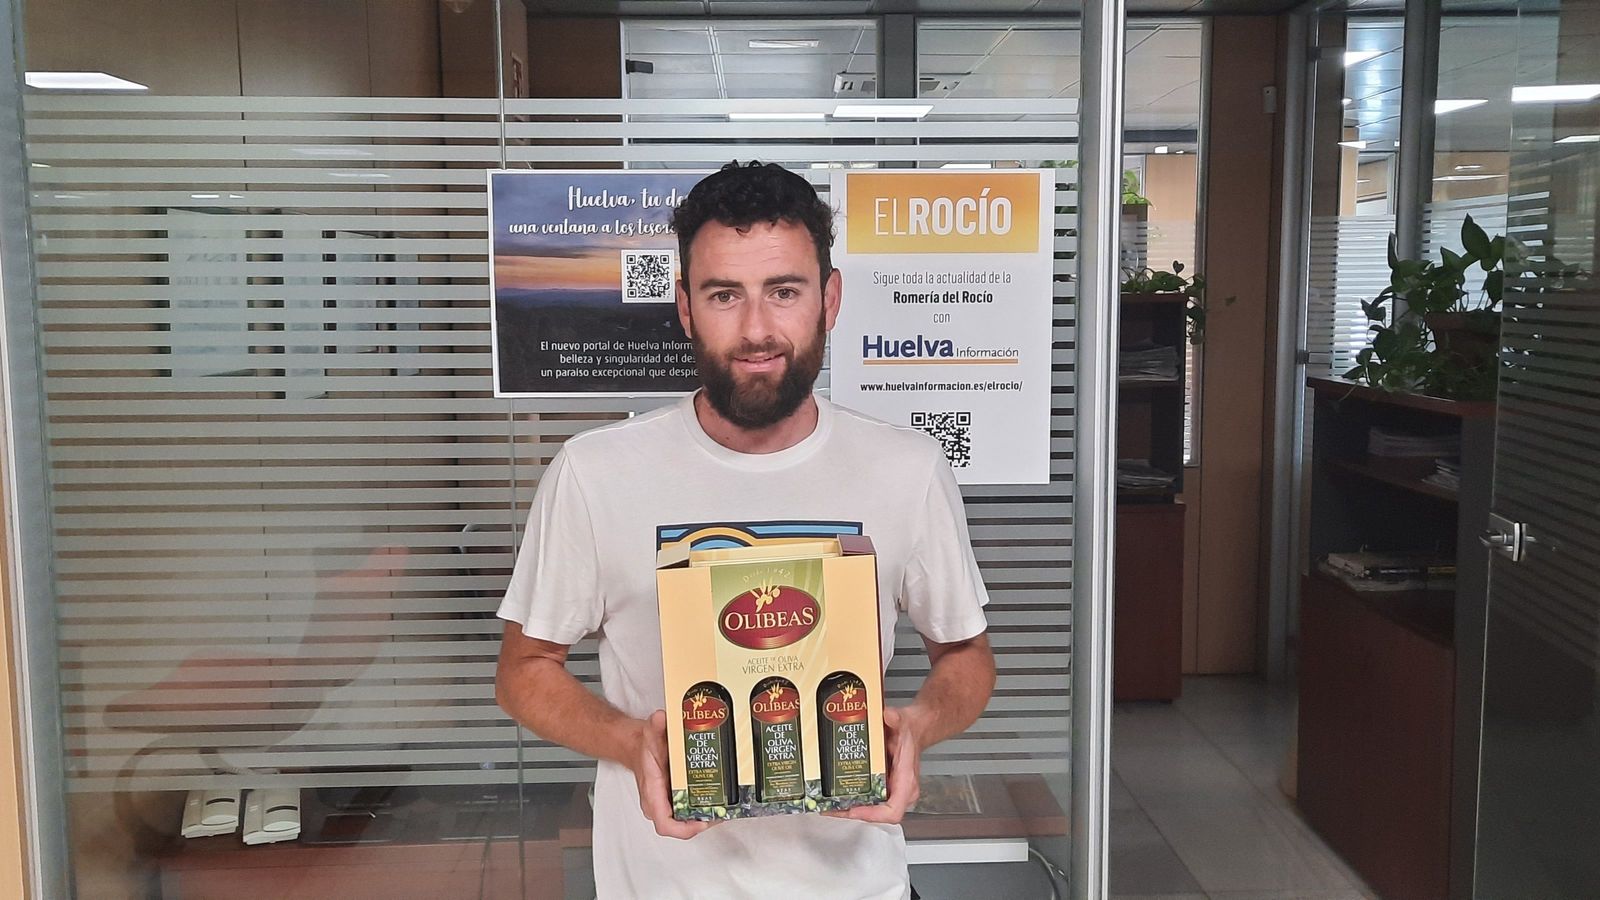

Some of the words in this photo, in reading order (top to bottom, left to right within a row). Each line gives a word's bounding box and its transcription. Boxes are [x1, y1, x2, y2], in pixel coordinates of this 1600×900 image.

[568, 185, 636, 211] Huelva,
[640, 187, 662, 208] tu
[509, 223, 539, 235] una
[541, 218, 599, 235] ventana
[601, 224, 613, 234] a
[615, 219, 636, 237] los
[873, 271, 900, 287] Sigue
[902, 271, 923, 284] toda
[925, 271, 934, 284] la
[936, 270, 987, 284] actualidad
[989, 270, 1000, 284] de
[1002, 270, 1012, 284] la
[893, 290, 940, 304] Romería
[942, 290, 960, 304] del
[962, 290, 993, 304] Rocío
[933, 313, 951, 323] con
[540, 341, 549, 350] El
[551, 342, 581, 351] nuevo
[583, 341, 610, 352] portal
[613, 341, 625, 350] de
[627, 341, 660, 350] Huelva
[862, 335, 954, 358] Huelva
[956, 346, 1019, 358] Información
[560, 353, 593, 364] belleza
[596, 355, 602, 365] y
[604, 353, 661, 365] singularidad
[663, 353, 679, 363] del
[540, 368, 553, 377] un
[555, 367, 590, 379] paraíso
[591, 367, 646, 379] excepcional
[648, 368, 667, 379] que
[860, 381, 1024, 392] www.huelvainformacion.es/elrocio/
[724, 606, 815, 631] OLIBEAS
[747, 656, 768, 665] ACEITE
[777, 655, 799, 663] OLIVA
[742, 664, 775, 675] VIRGEN
[777, 661, 805, 673] EXTRA
[752, 699, 800, 713] OLIBEAS
[765, 724, 793, 733] ACEITE
[837, 723, 865, 733] ACEITE
[688, 732, 716, 740] ACEITE
[767, 738, 794, 747] OLIVA
[839, 738, 865, 747] OLIVA
[765, 745, 797, 754] VIRGEN
[836, 745, 868, 754] VIRGEN
[686, 753, 719, 762] VIRGEN
[768, 752, 795, 761] EXTRA
[839, 752, 866, 760] EXTRA
[690, 760, 717, 768] EXTRA
